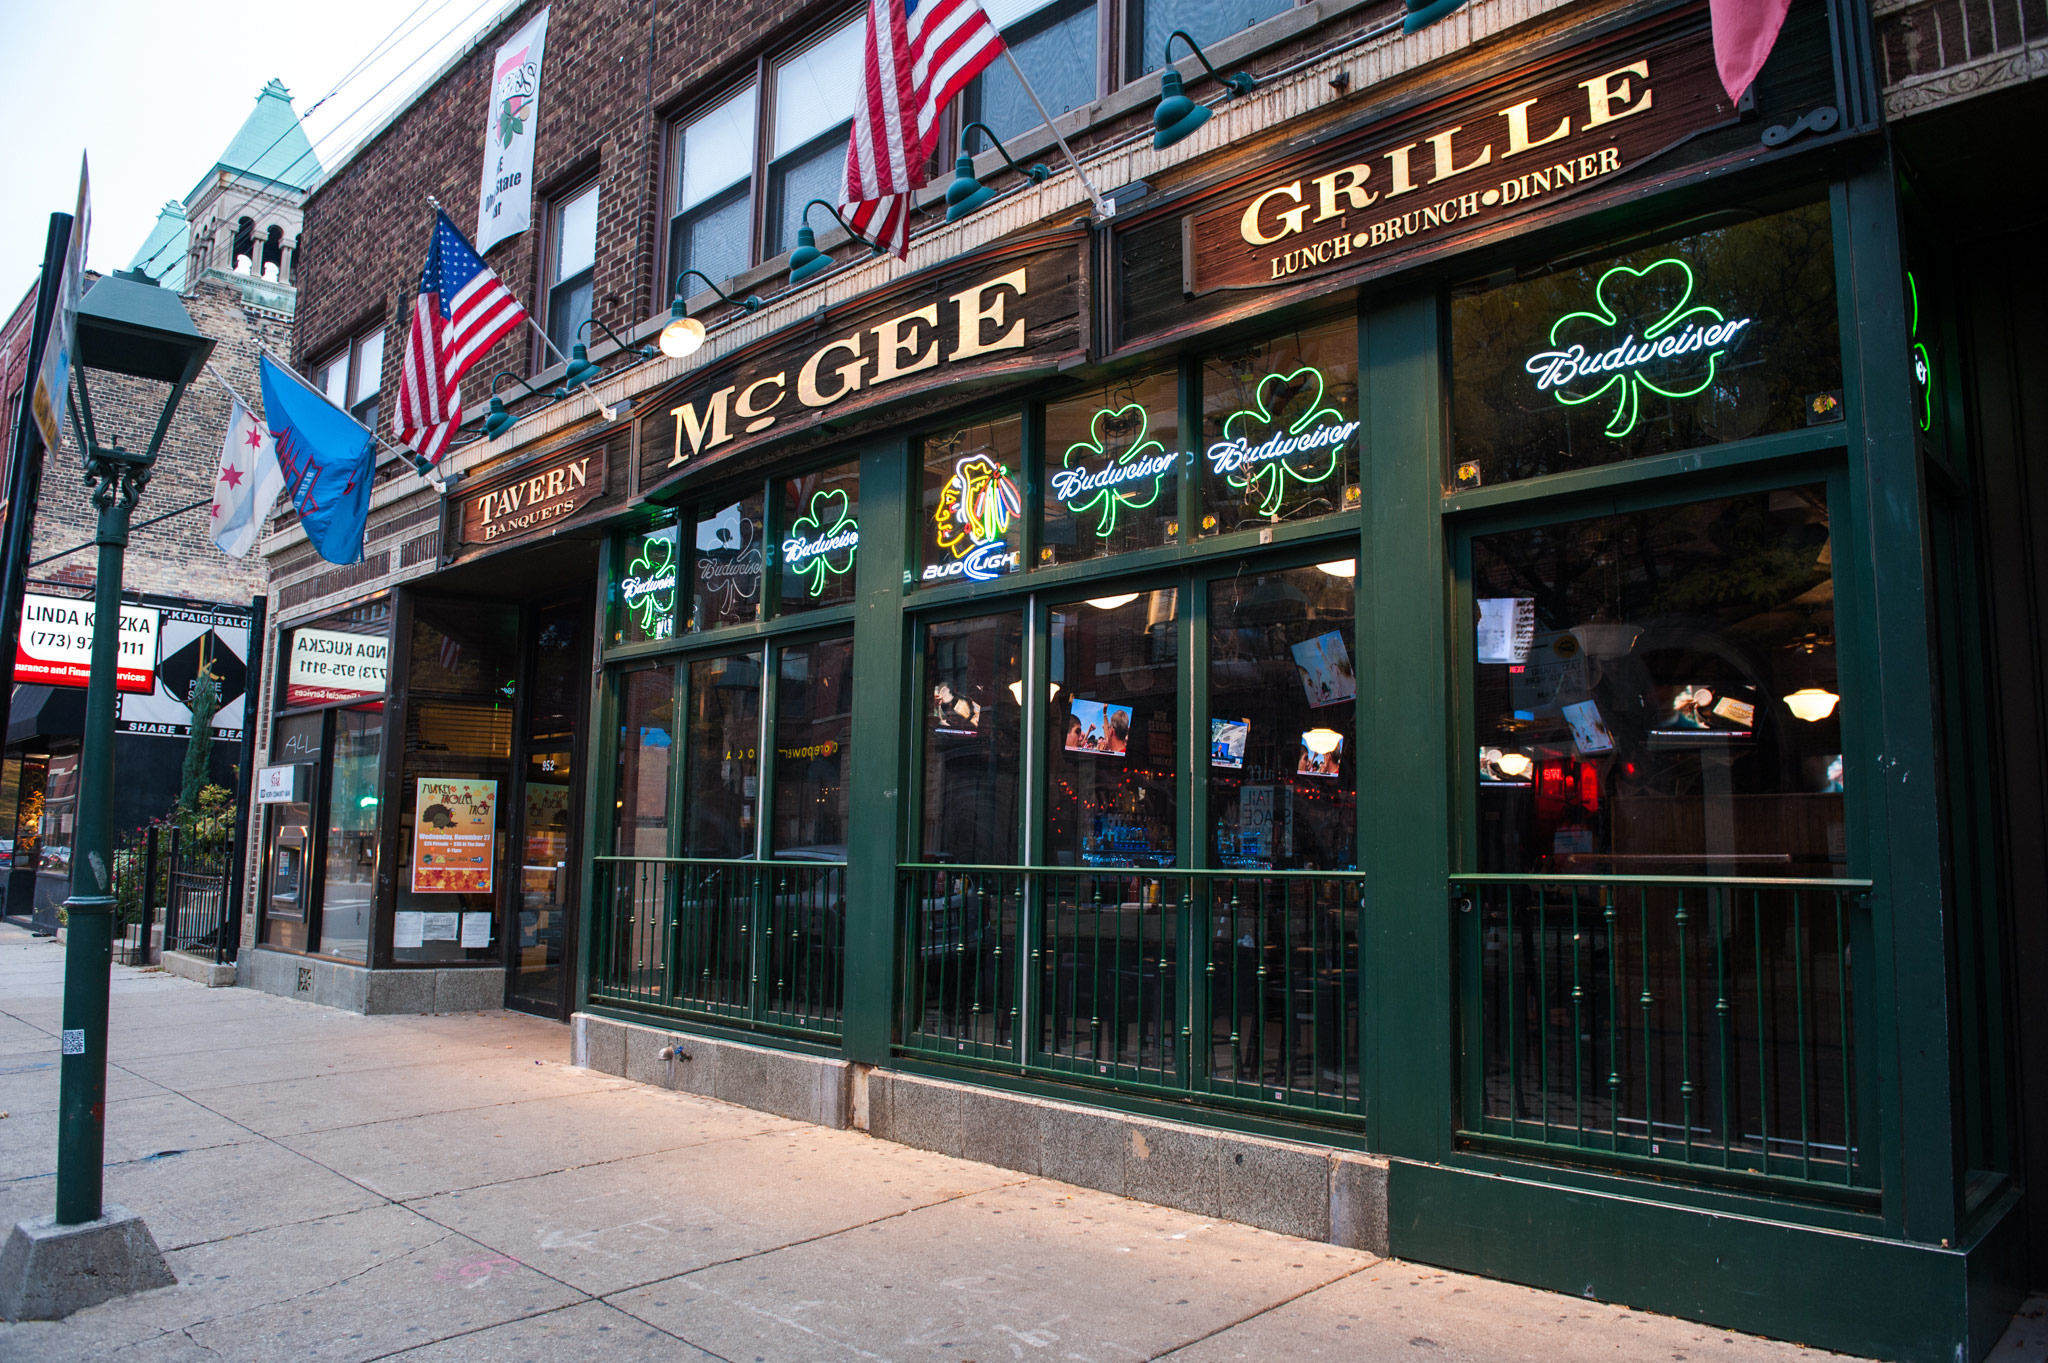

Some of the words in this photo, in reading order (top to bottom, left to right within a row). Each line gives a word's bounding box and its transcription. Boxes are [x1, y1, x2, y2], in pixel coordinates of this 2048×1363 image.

[1240, 59, 1652, 246] GRILLE
[1270, 228, 1352, 279] LUNCH
[1370, 192, 1479, 248] BRUNCH
[1500, 147, 1622, 206] DINNER
[1525, 318, 1750, 391] Budweiser
[1208, 420, 1360, 474] Budweiser
[1051, 451, 1178, 501] Budweiser
[478, 458, 590, 526] TAVERN
[484, 500, 575, 541] BANQUETS
[698, 557, 761, 579] Budweise
[922, 561, 963, 580] BUD
[973, 553, 1012, 571] LIGH
[26, 605, 79, 625] LINDA
[85, 612, 150, 633] KZKA
[30, 630, 71, 650] (773)
[77, 637, 144, 655] 97111
[14, 663, 49, 674] surance
[51, 665, 66, 675] and
[68, 666, 91, 677] Finan
[117, 671, 146, 682] ervices
[189, 680, 222, 692] PGE
[128, 722, 176, 734] SHARE
[218, 728, 243, 738] BEA
[542, 760, 555, 771] 952
